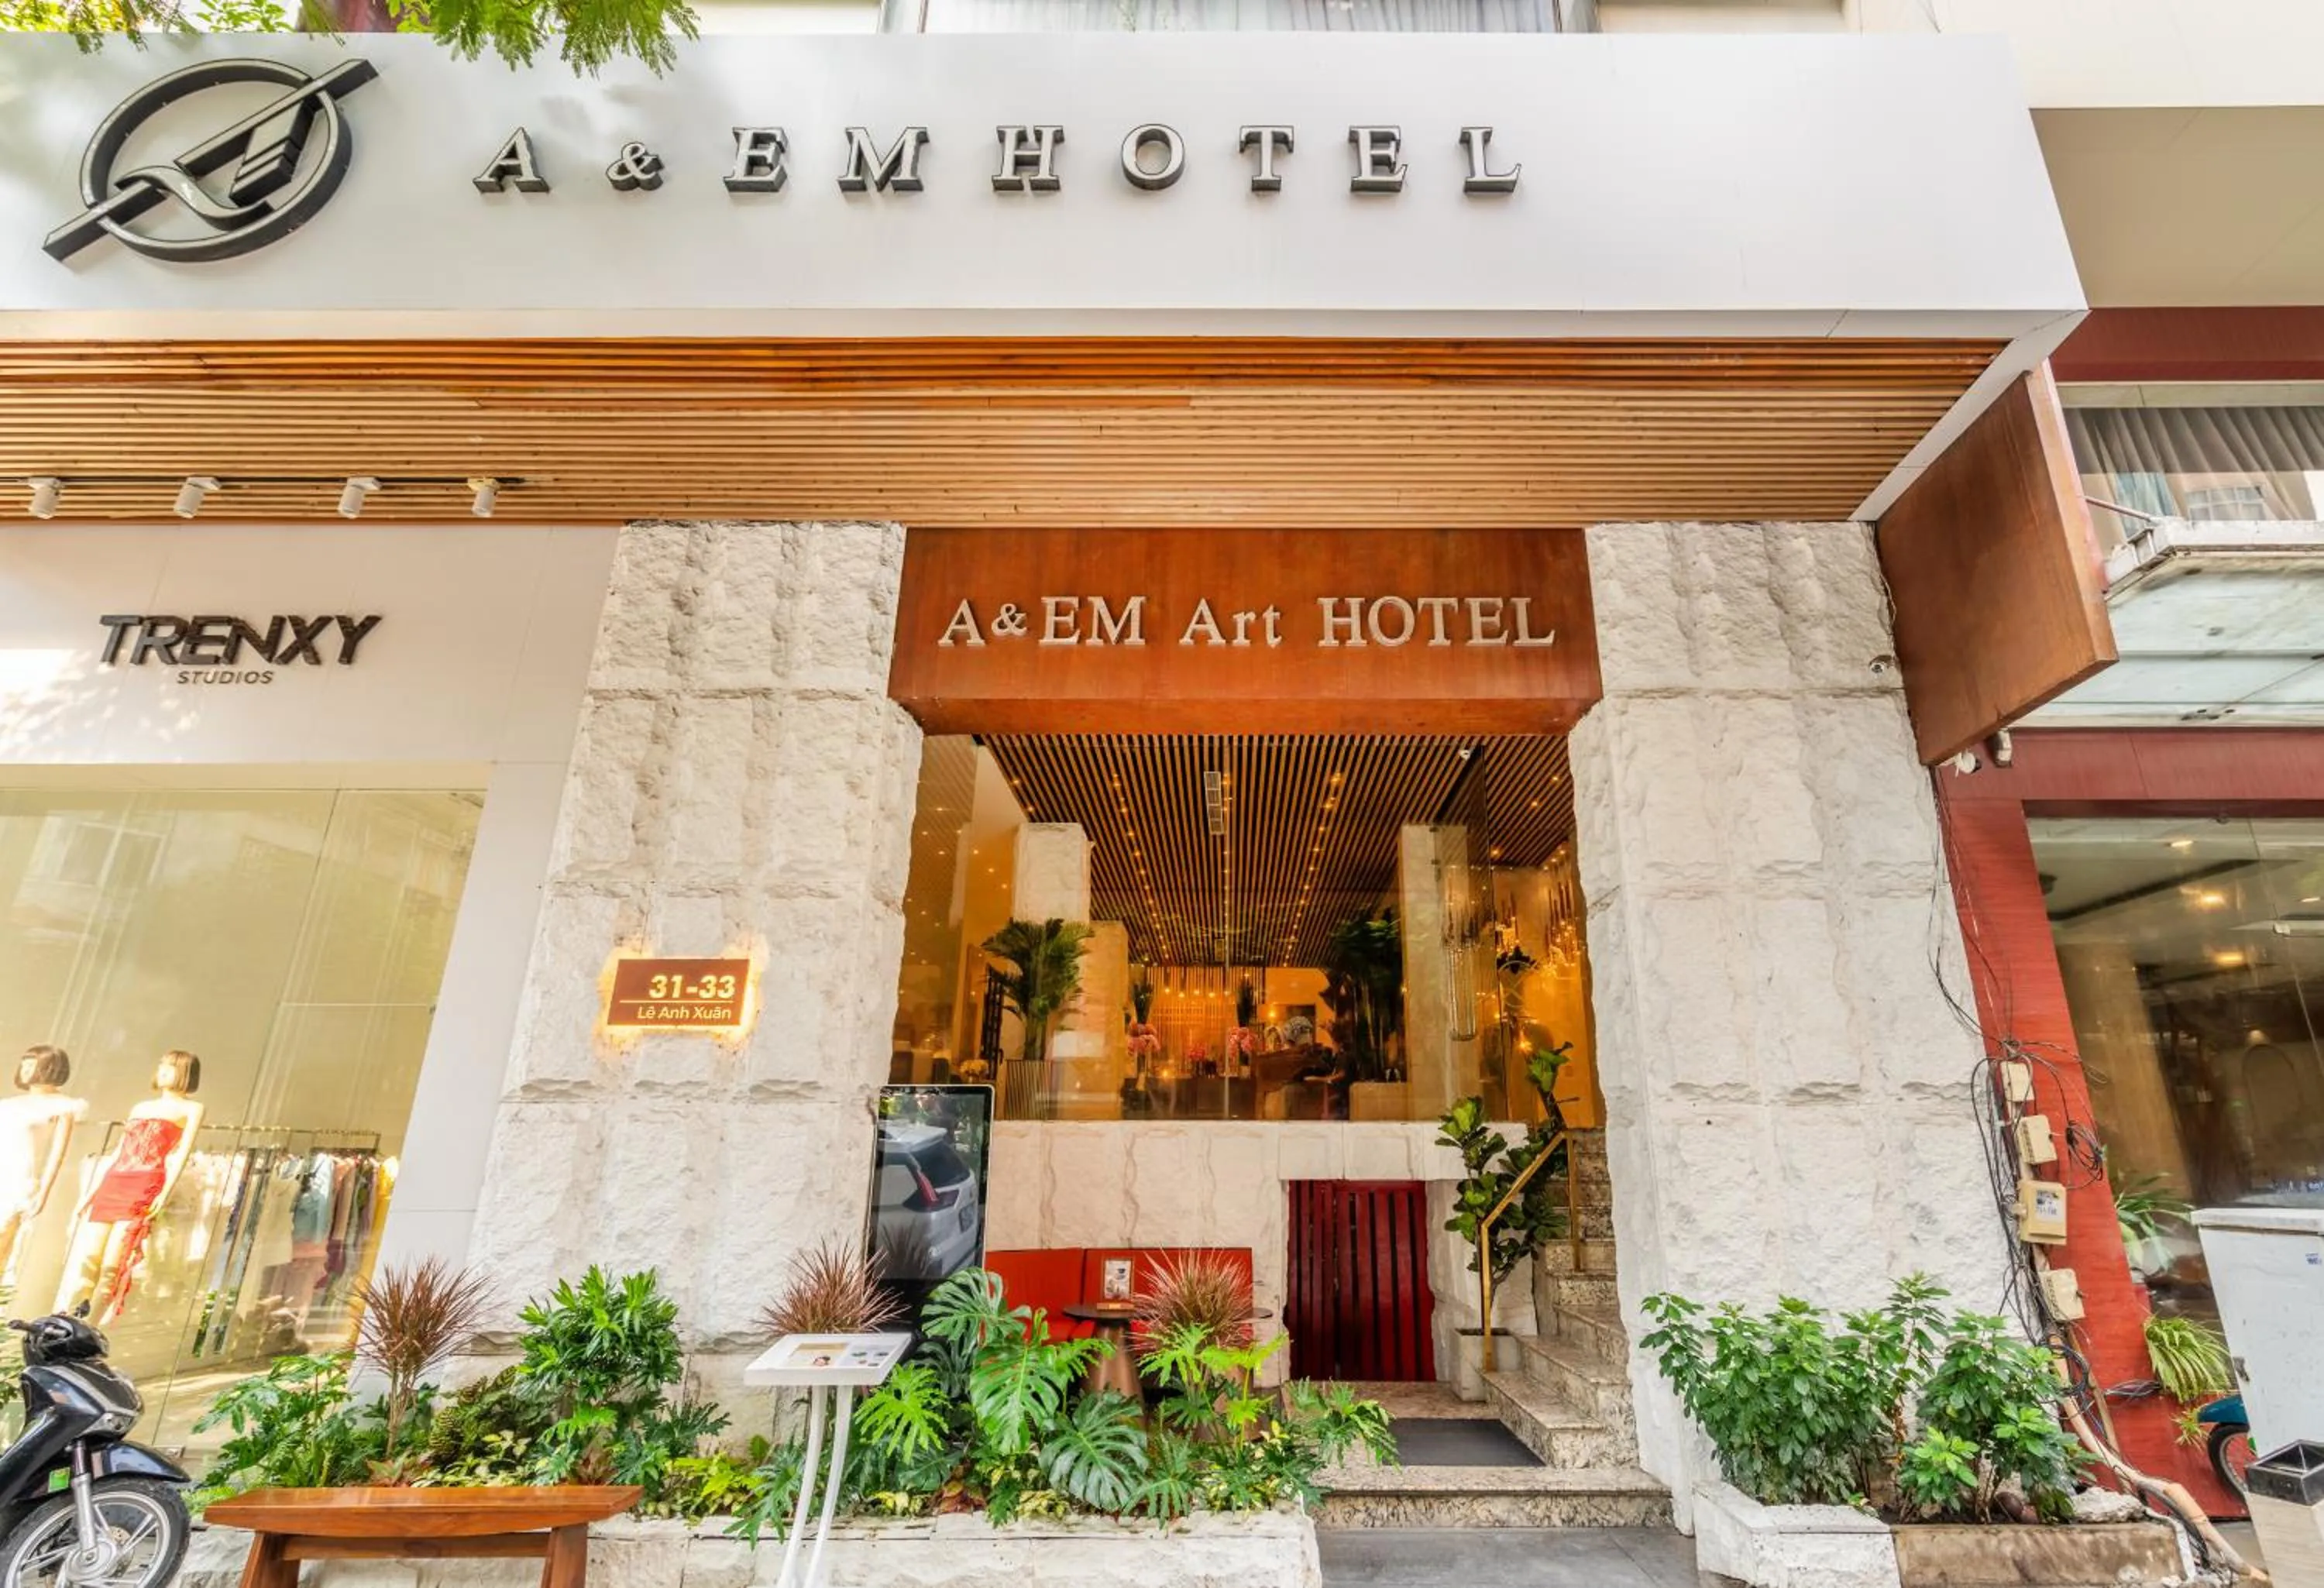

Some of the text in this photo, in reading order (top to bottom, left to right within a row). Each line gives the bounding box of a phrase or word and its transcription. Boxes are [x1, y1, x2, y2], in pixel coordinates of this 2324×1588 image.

[473, 126, 550, 193] A
[605, 141, 665, 191] &
[992, 123, 1522, 193] HOTEL
[99, 614, 383, 666] TRENXY
[1179, 597, 1283, 649] Art
[1317, 595, 1556, 648] HOTEL
[177, 669, 275, 685] STUDIOS
[648, 974, 736, 999] 31-33
[637, 1005, 731, 1019] Lê Anh Xuân
